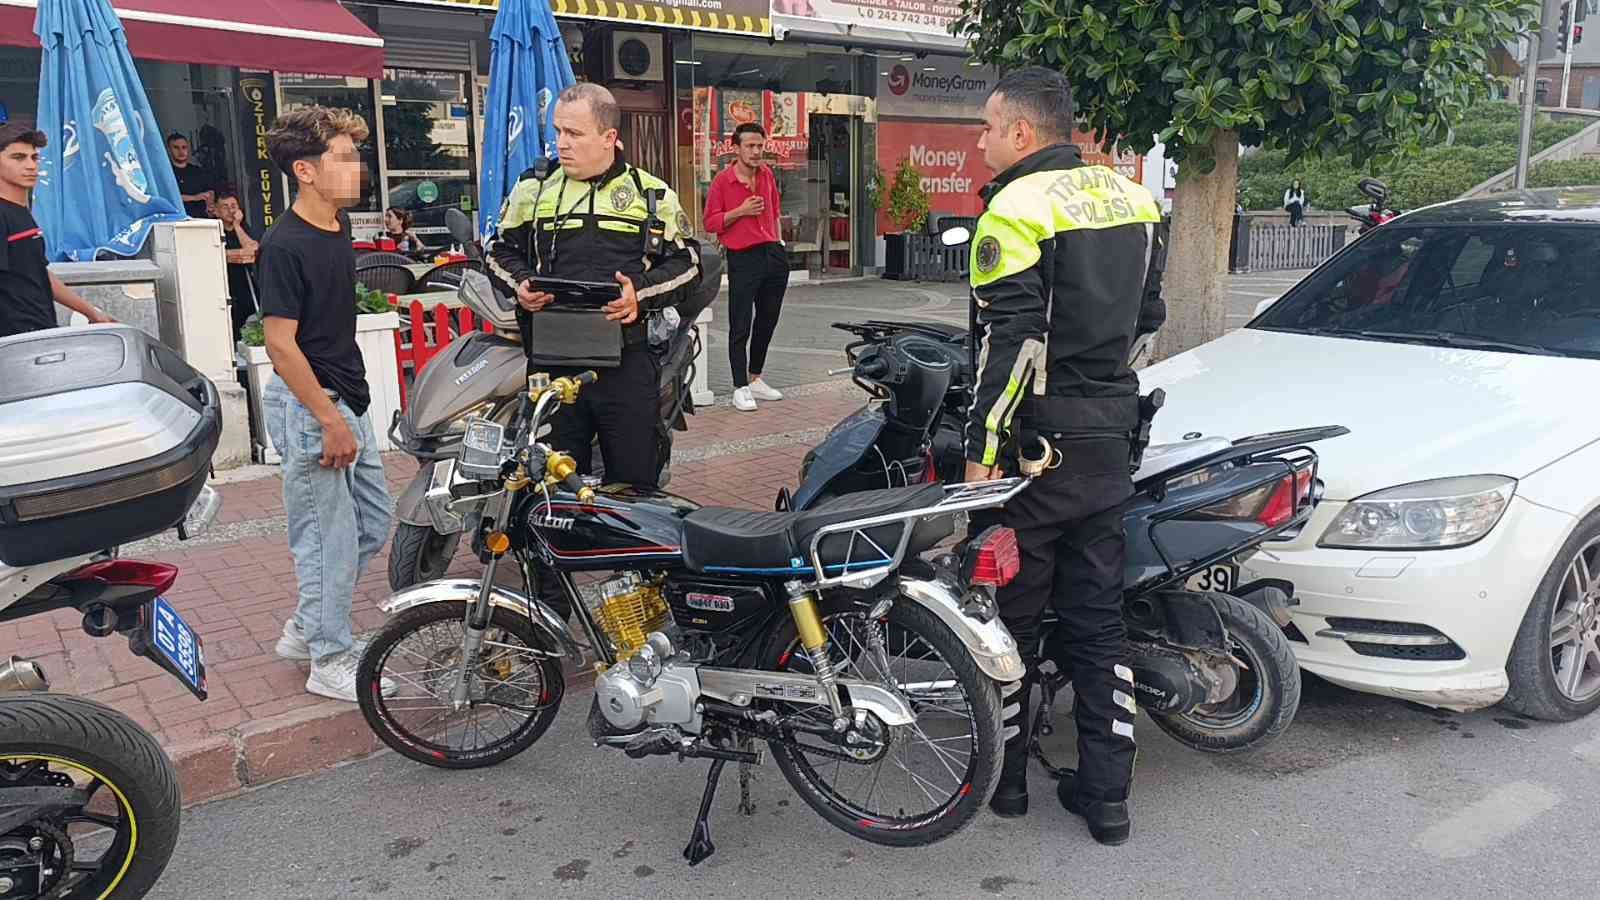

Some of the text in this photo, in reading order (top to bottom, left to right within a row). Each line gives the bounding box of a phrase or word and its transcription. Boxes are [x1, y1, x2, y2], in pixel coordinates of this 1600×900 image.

[866, 9, 874, 18] 0
[878, 10, 897, 21] 242
[901, 12, 920, 24] 742
[923, 15, 937, 26] 34
[911, 72, 987, 93] MoneyGram
[909, 144, 967, 171] Money
[918, 171, 972, 193] ansfer
[1063, 196, 1136, 222] POLİSİ
[1197, 566, 1229, 593] 39
[157, 605, 176, 653] 07 A
